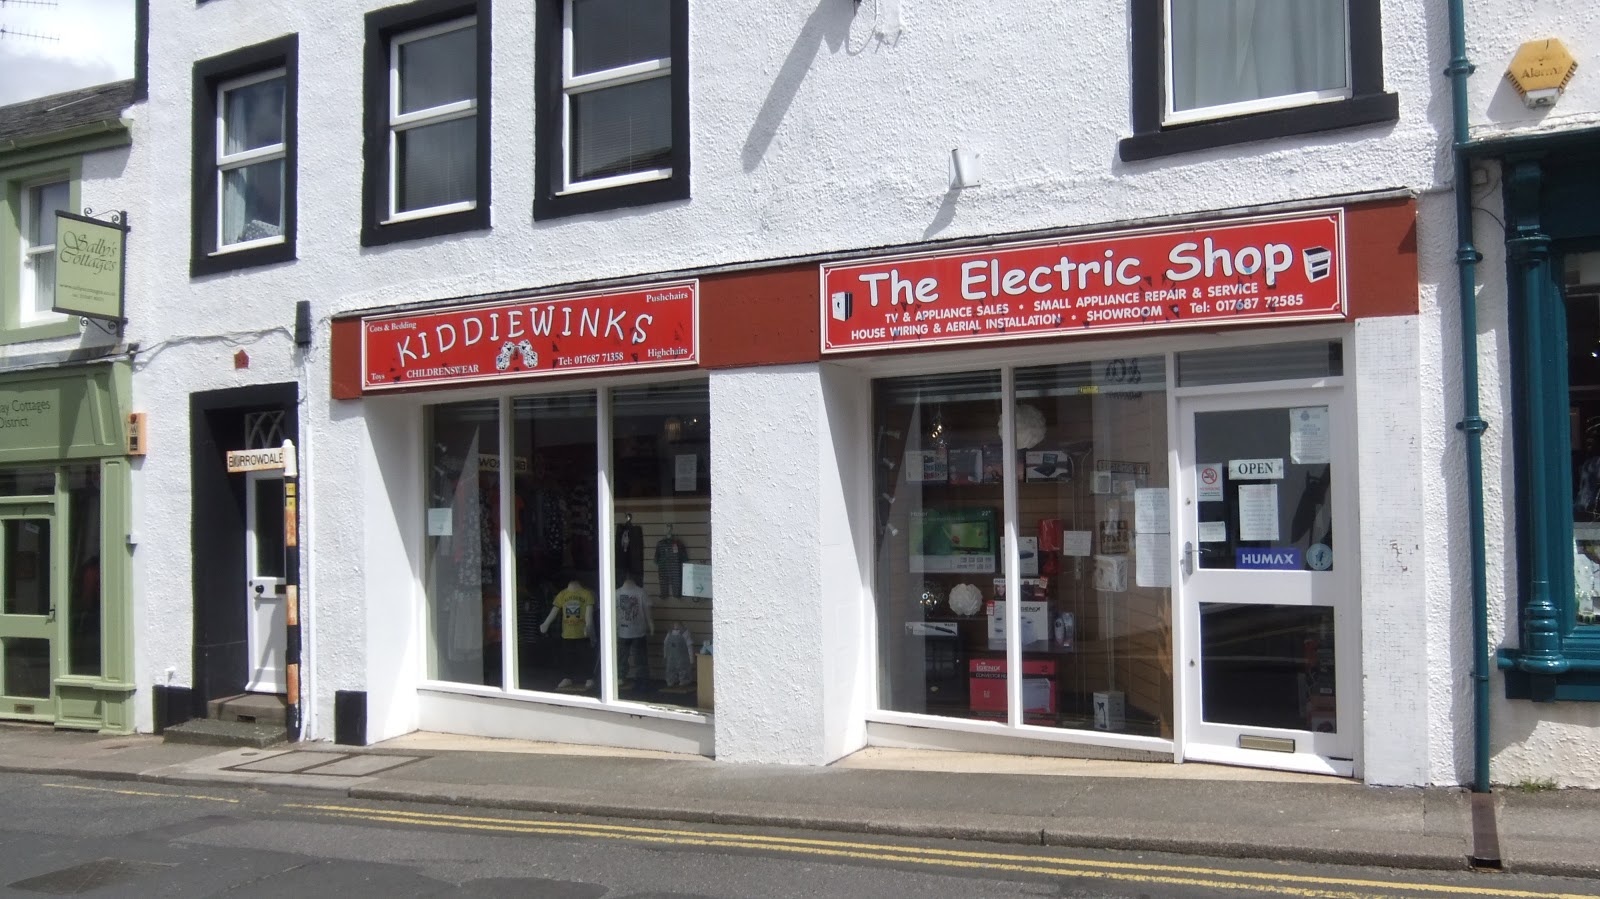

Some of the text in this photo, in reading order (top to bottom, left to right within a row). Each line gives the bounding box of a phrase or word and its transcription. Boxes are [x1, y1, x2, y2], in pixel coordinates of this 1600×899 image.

[63, 230, 117, 257] Sally's
[60, 246, 117, 275] Cottages
[858, 237, 1293, 307] The Electric Shop
[646, 291, 689, 303] Pushchairs
[885, 282, 1258, 323] TV & APPLIANCE SALES SMALL APPLIANCE REPAIR & SERVICE
[851, 294, 1304, 340] HOUSE WIRING & AERIAL INSTALLATION SHOWROOM Tel: 017687 72585
[369, 324, 383, 333] Cots
[391, 321, 417, 330] Bedding
[397, 305, 653, 368] KIDDIEWINKS
[558, 352, 624, 365] Tel: 017687 71358
[647, 346, 688, 358] Highchairs
[371, 373, 385, 381] Toys
[406, 364, 479, 379] CHILDRENSWEAR
[12, 399, 51, 414] Cottages
[228, 452, 284, 468] BORROWDALE
[1238, 462, 1274, 475] OPEN
[1241, 553, 1294, 565] HUMAX
